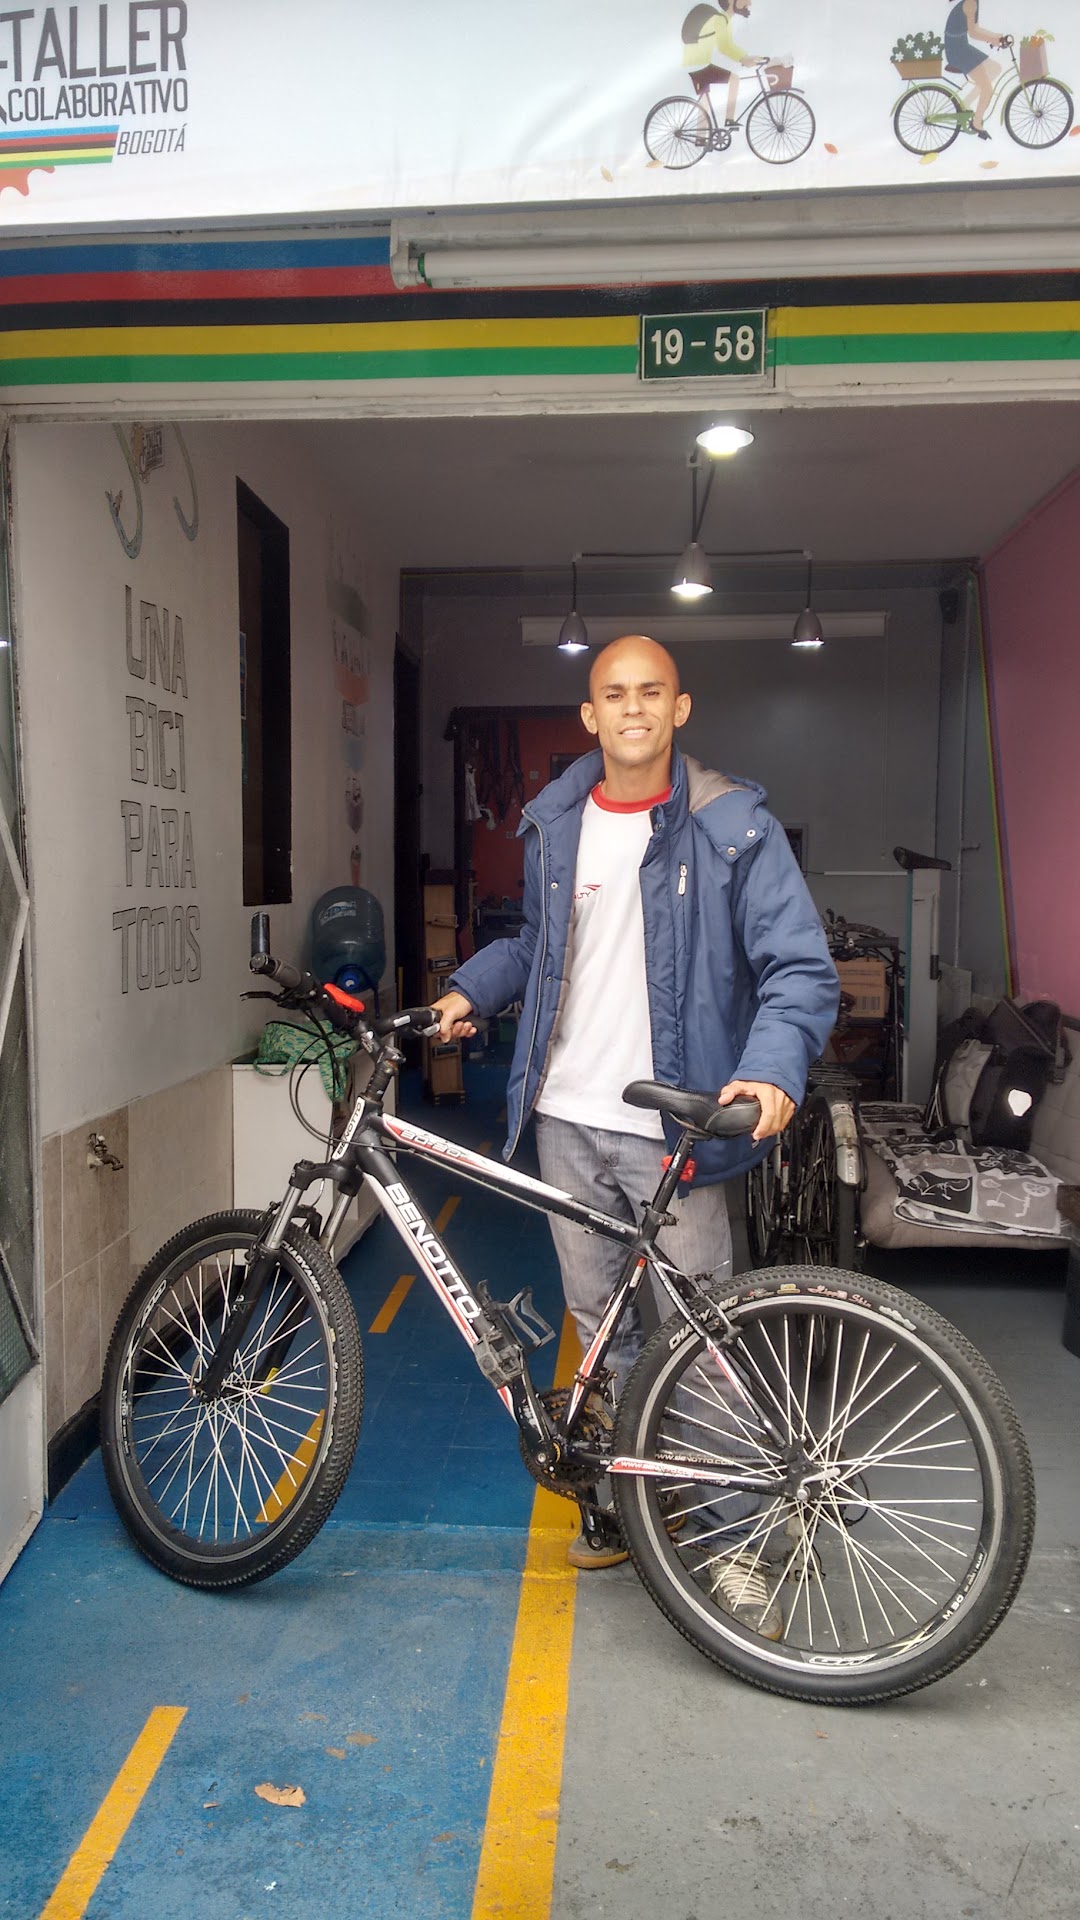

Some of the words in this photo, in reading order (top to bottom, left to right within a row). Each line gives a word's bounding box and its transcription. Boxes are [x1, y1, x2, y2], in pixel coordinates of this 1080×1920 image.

[8, 78, 188, 122] COLABORATIVO
[117, 123, 188, 155] BOGOTÁ
[125, 585, 188, 699] UNA
[126, 695, 185, 793] BICI
[121, 800, 197, 888] PARA
[112, 905, 201, 995] TODOS
[386, 1183, 482, 1321] BENOTTO
